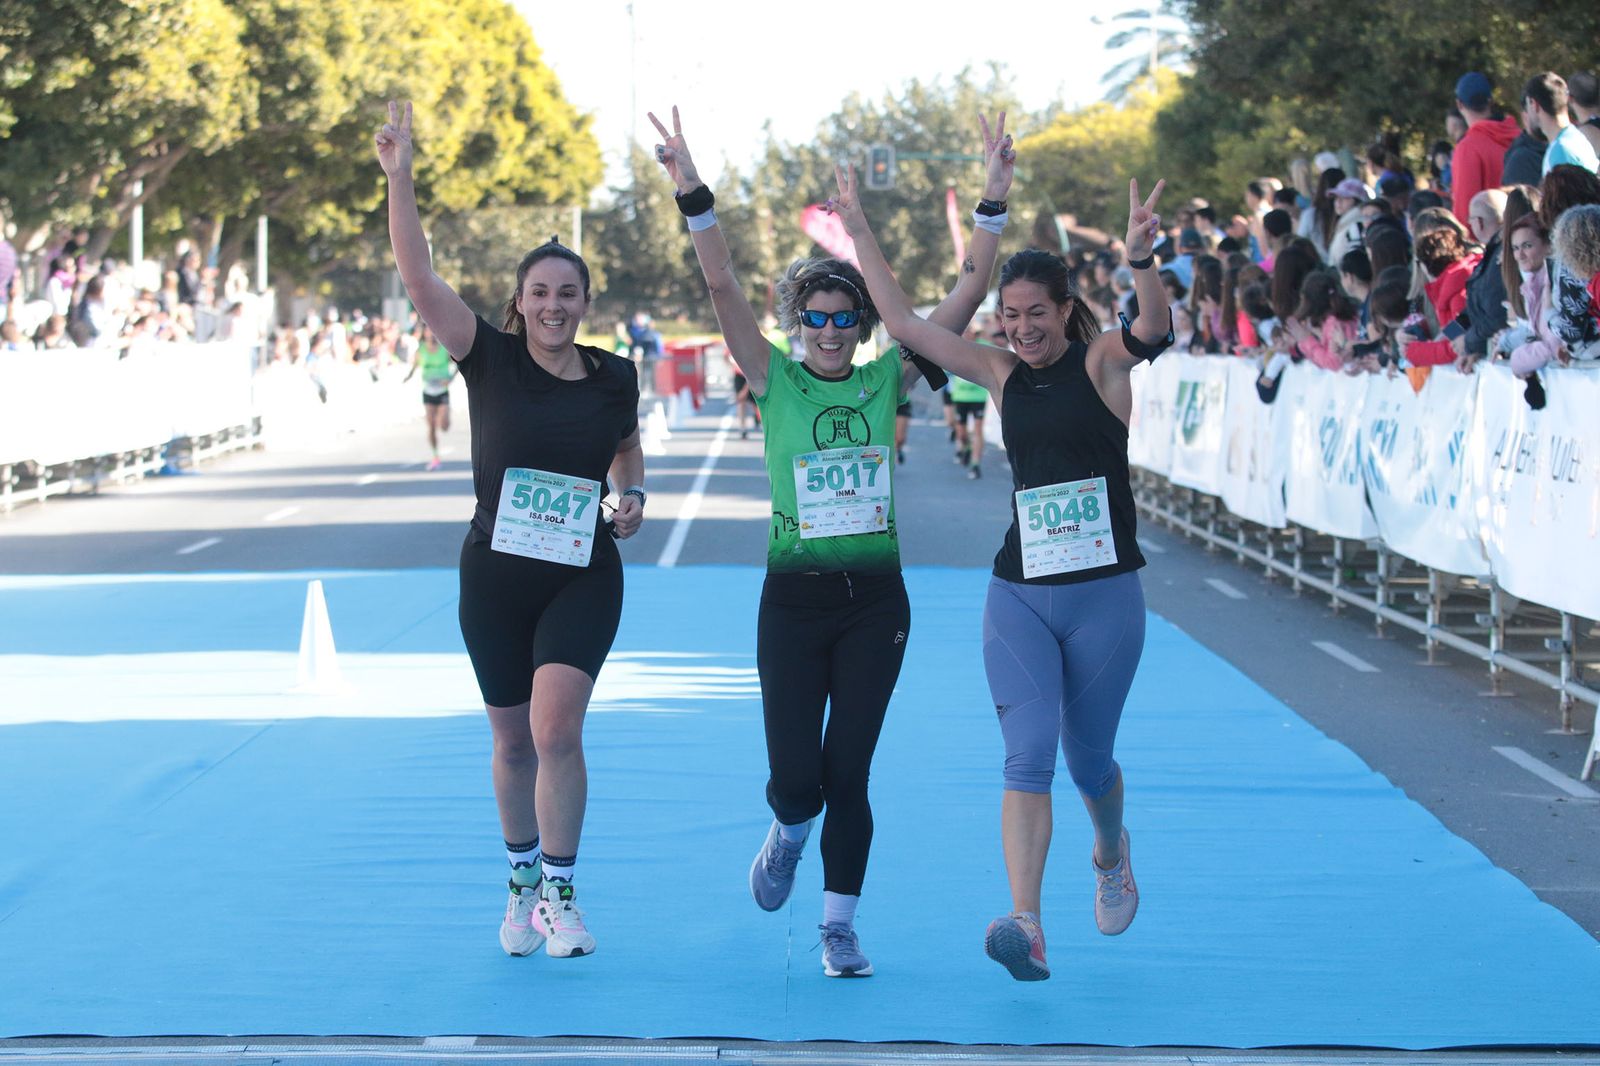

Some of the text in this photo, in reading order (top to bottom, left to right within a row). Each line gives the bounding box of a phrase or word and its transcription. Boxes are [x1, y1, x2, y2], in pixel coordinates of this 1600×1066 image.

[806, 461, 881, 493] 5017
[835, 488, 857, 498] INMA
[1057, 489, 1070, 497] 2022
[511, 483, 592, 520] 5047
[529, 511, 542, 521] ISA
[544, 514, 566, 525] SOLA
[1028, 495, 1101, 531] 5048
[1047, 524, 1081, 536] BEATRIZ
